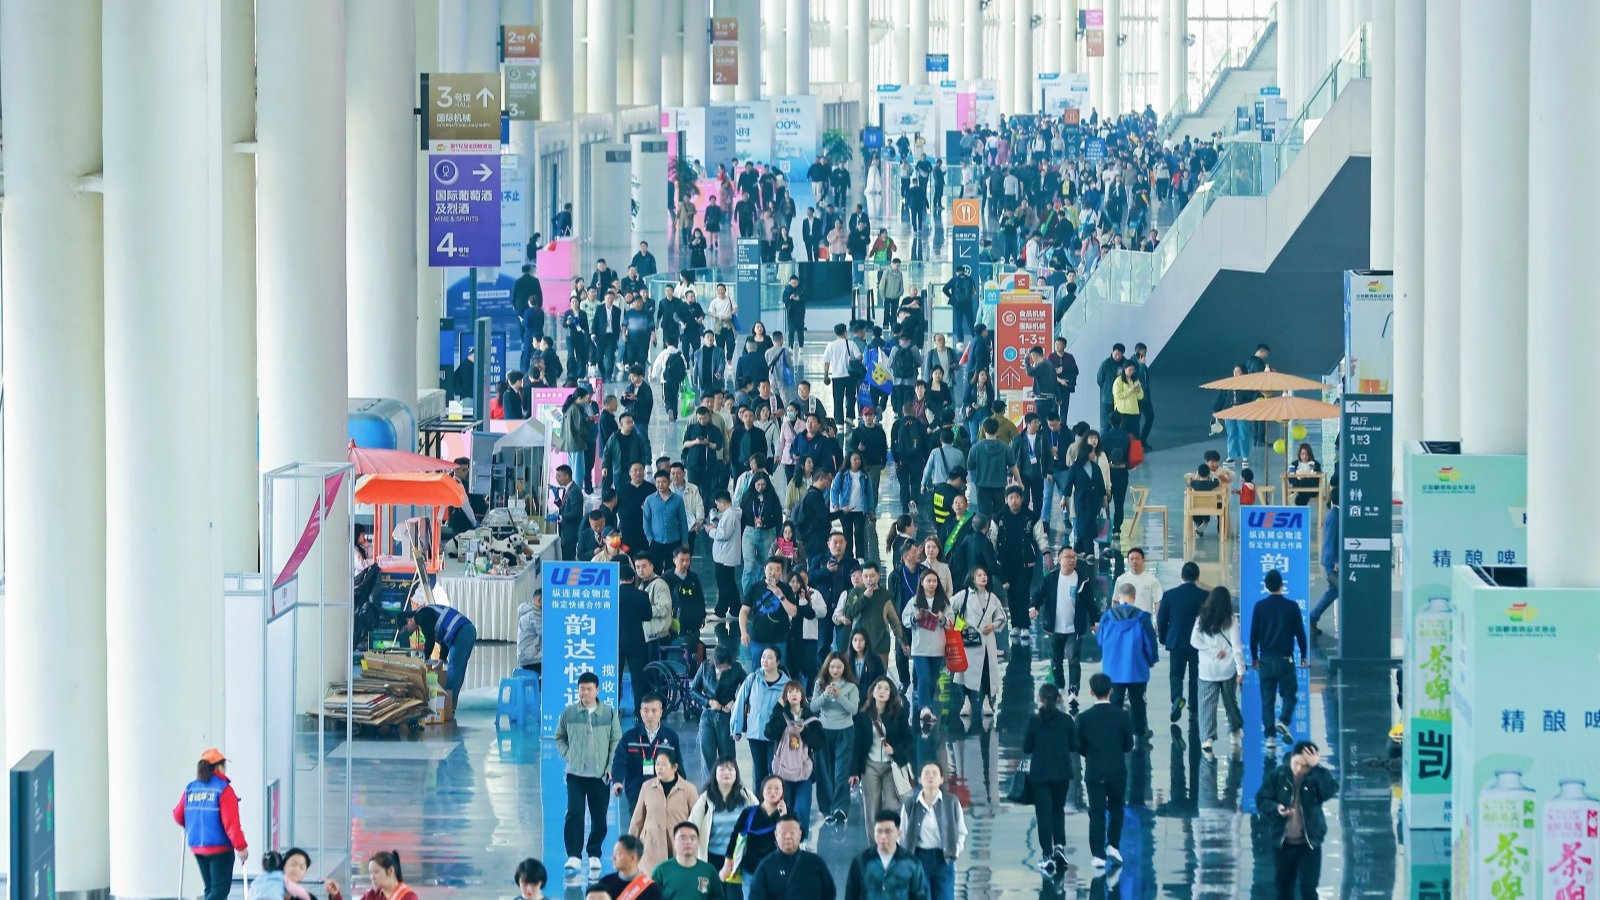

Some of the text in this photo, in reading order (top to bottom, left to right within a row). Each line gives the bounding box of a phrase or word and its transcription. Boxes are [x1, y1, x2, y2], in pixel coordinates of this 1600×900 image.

[436, 113, 472, 122] 国际机械
[435, 190, 493, 201] 国际葡萄酒
[435, 203, 470, 214] 及烈酒
[1350, 416, 1368, 425] 展厅
[1350, 453, 1367, 462] 入口
[1350, 471, 1358, 481] B
[1249, 531, 1303, 539] 纵连展会物流
[1249, 541, 1303, 549] 指定快递合作商
[1350, 553, 1367, 562] 展厅
[1349, 571, 1357, 582] 4
[552, 589, 611, 598] 纵连展会物流
[552, 600, 611, 610] 指定快递合作商
